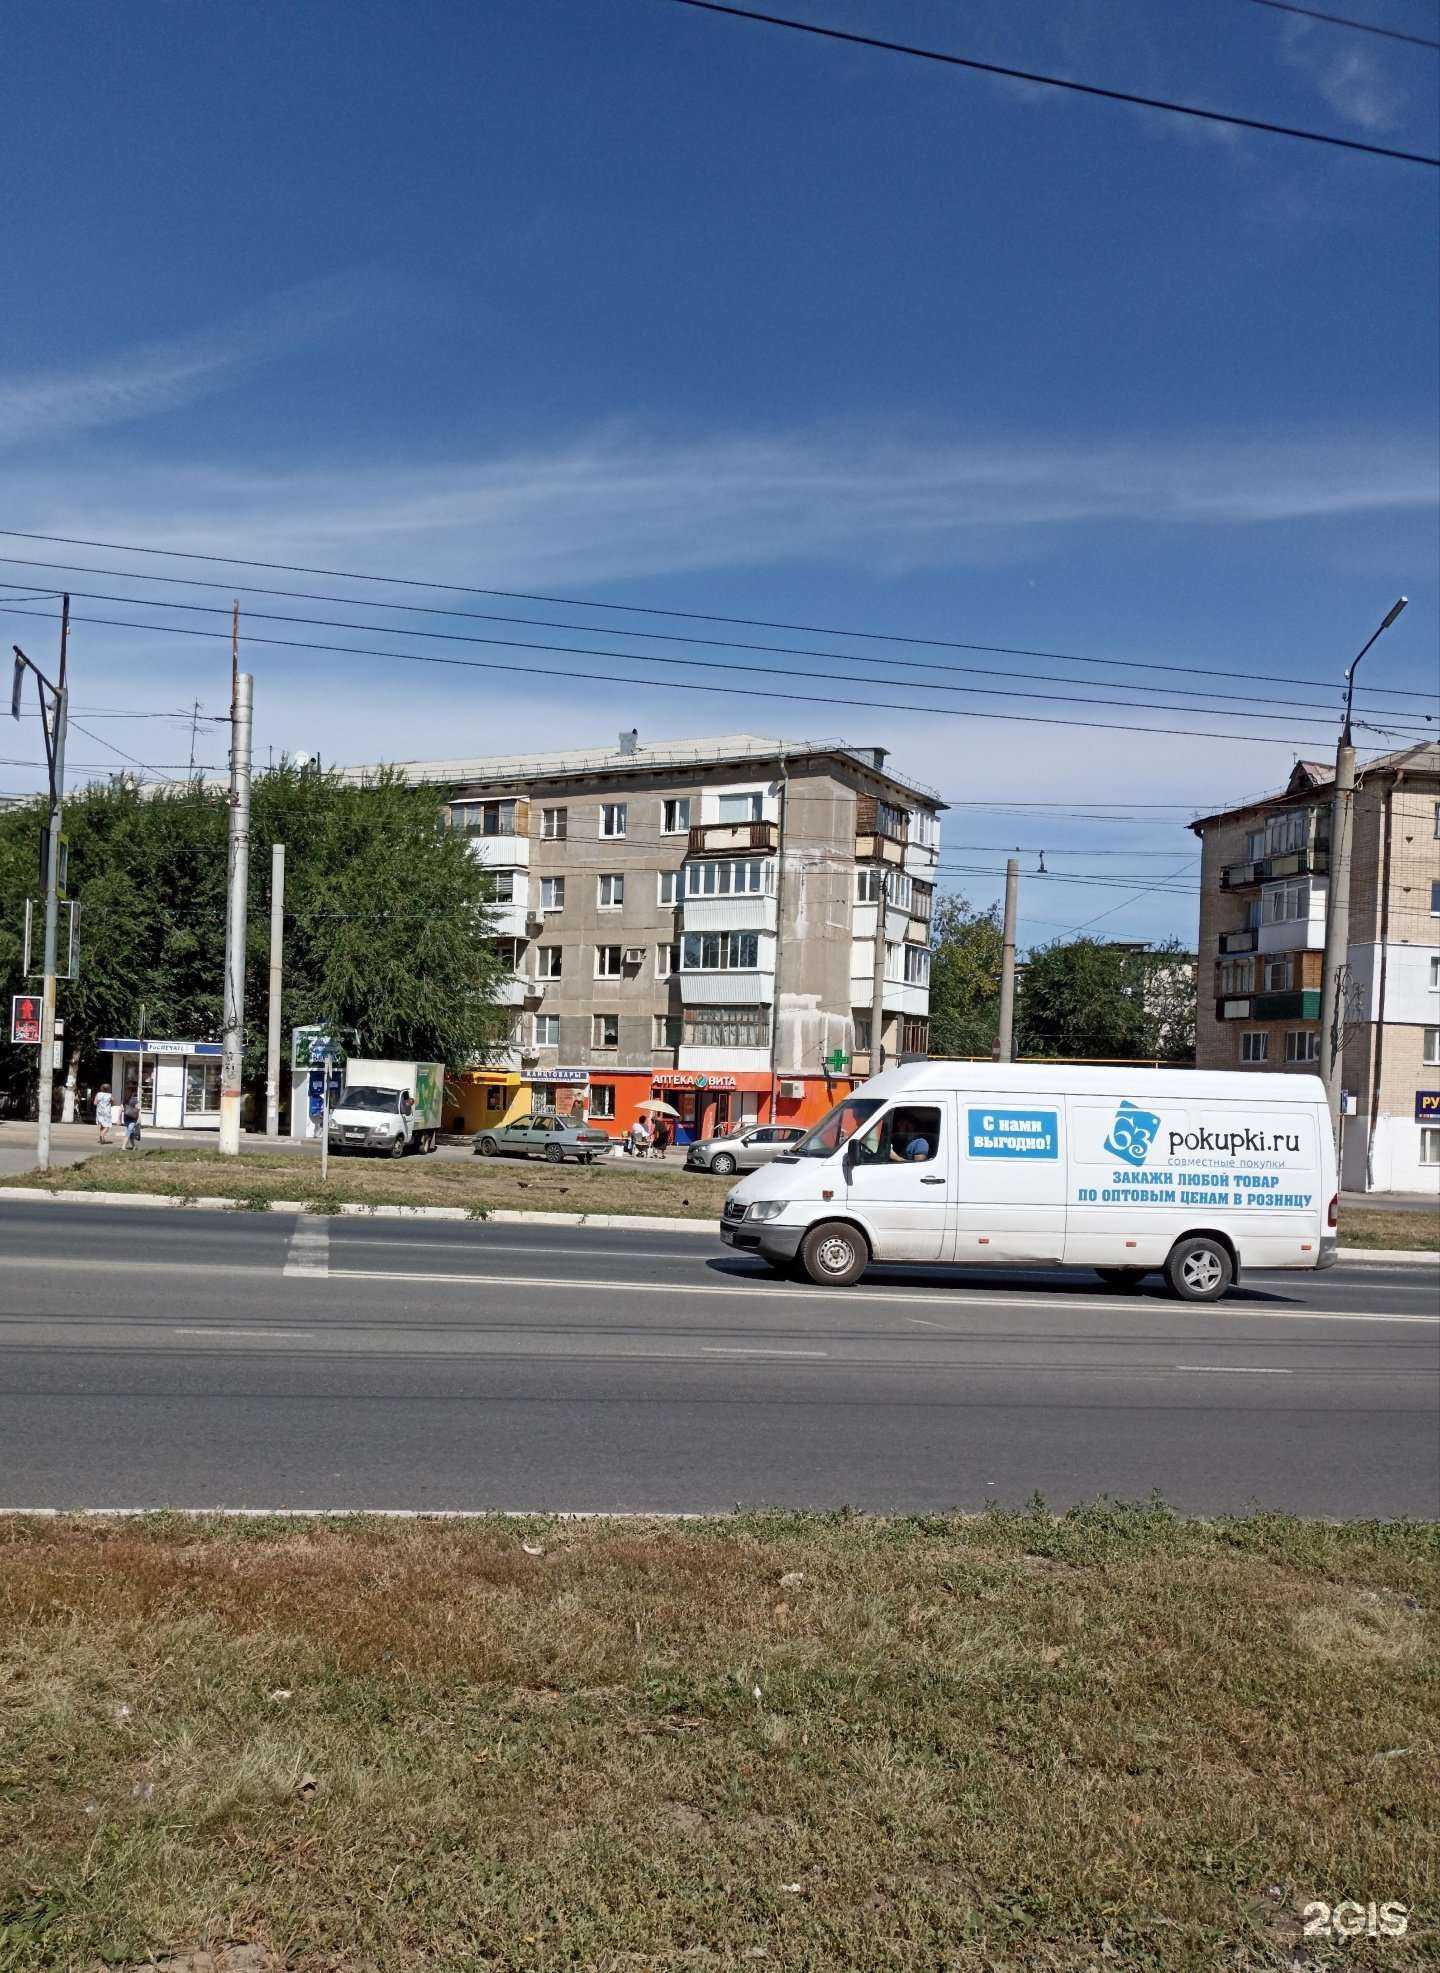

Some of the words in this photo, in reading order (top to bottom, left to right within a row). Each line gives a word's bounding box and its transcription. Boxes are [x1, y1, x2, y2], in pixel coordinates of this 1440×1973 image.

[652, 1074, 694, 1085] АПТЕКА
[708, 1075, 736, 1086] ВИТА
[1422, 1096, 1440, 1109] РУ
[983, 1115, 995, 1131] С
[998, 1118, 1042, 1133] нами
[973, 1134, 1051, 1152] выгодно!
[1108, 1116, 1151, 1158] 63
[1168, 1127, 1300, 1157] pokupki.ru
[1167, 1158, 1236, 1168] совместные
[1240, 1159, 1286, 1169] покупки
[1112, 1171, 1173, 1185] ЗАКАЖИ
[1177, 1172, 1229, 1187] ЛЮБОЙ
[1233, 1175, 1279, 1188] ТОВАР
[1078, 1188, 1098, 1201] ПО
[1101, 1189, 1176, 1203] ОПТОВЫМ
[1180, 1191, 1229, 1205] ЦЕНАМ
[1233, 1193, 1243, 1206] В
[1249, 1194, 1312, 1209] РОЗНИЦУ
